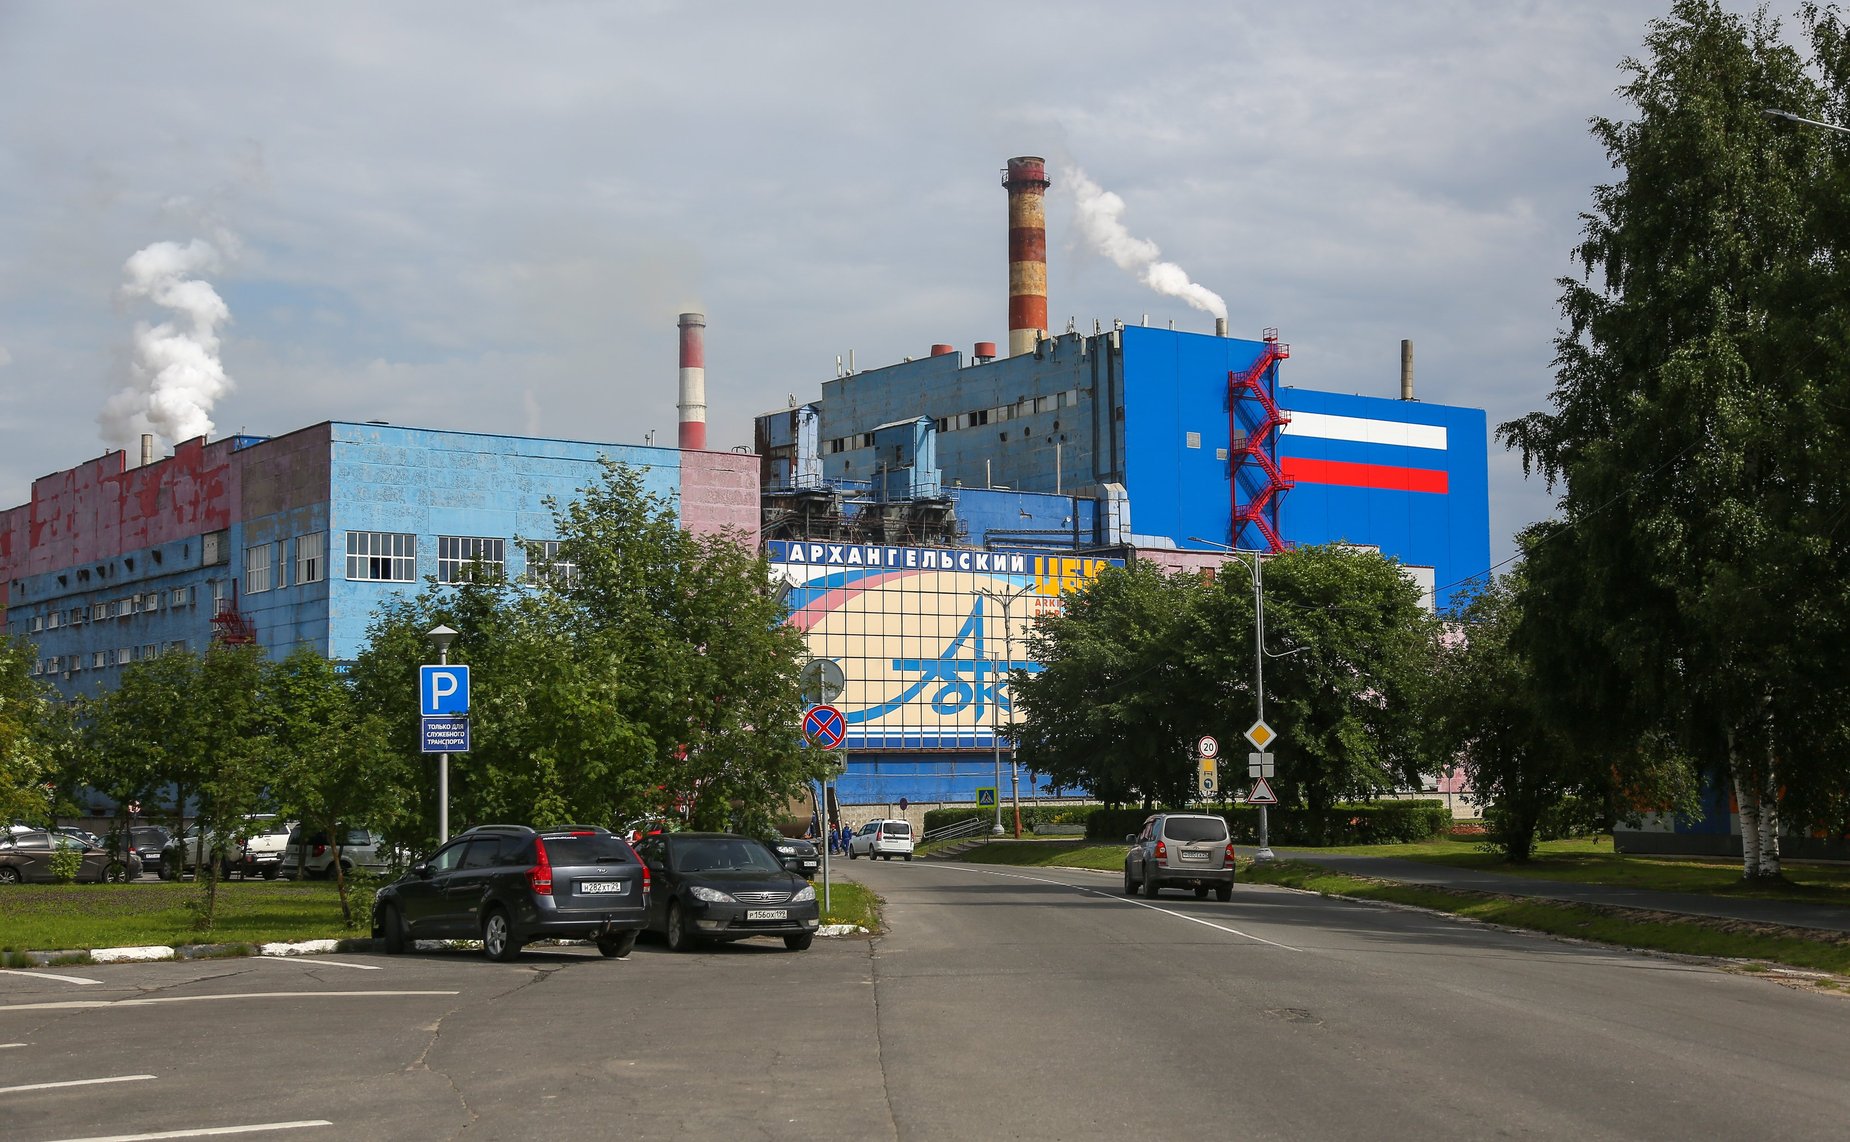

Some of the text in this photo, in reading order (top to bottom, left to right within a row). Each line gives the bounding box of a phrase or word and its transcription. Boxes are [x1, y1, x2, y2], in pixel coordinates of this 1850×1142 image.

[789, 544, 1024, 572] АРХАНГЕЛЬСКИЙ
[432, 672, 458, 710] P
[1203, 742, 1214, 752] 20
